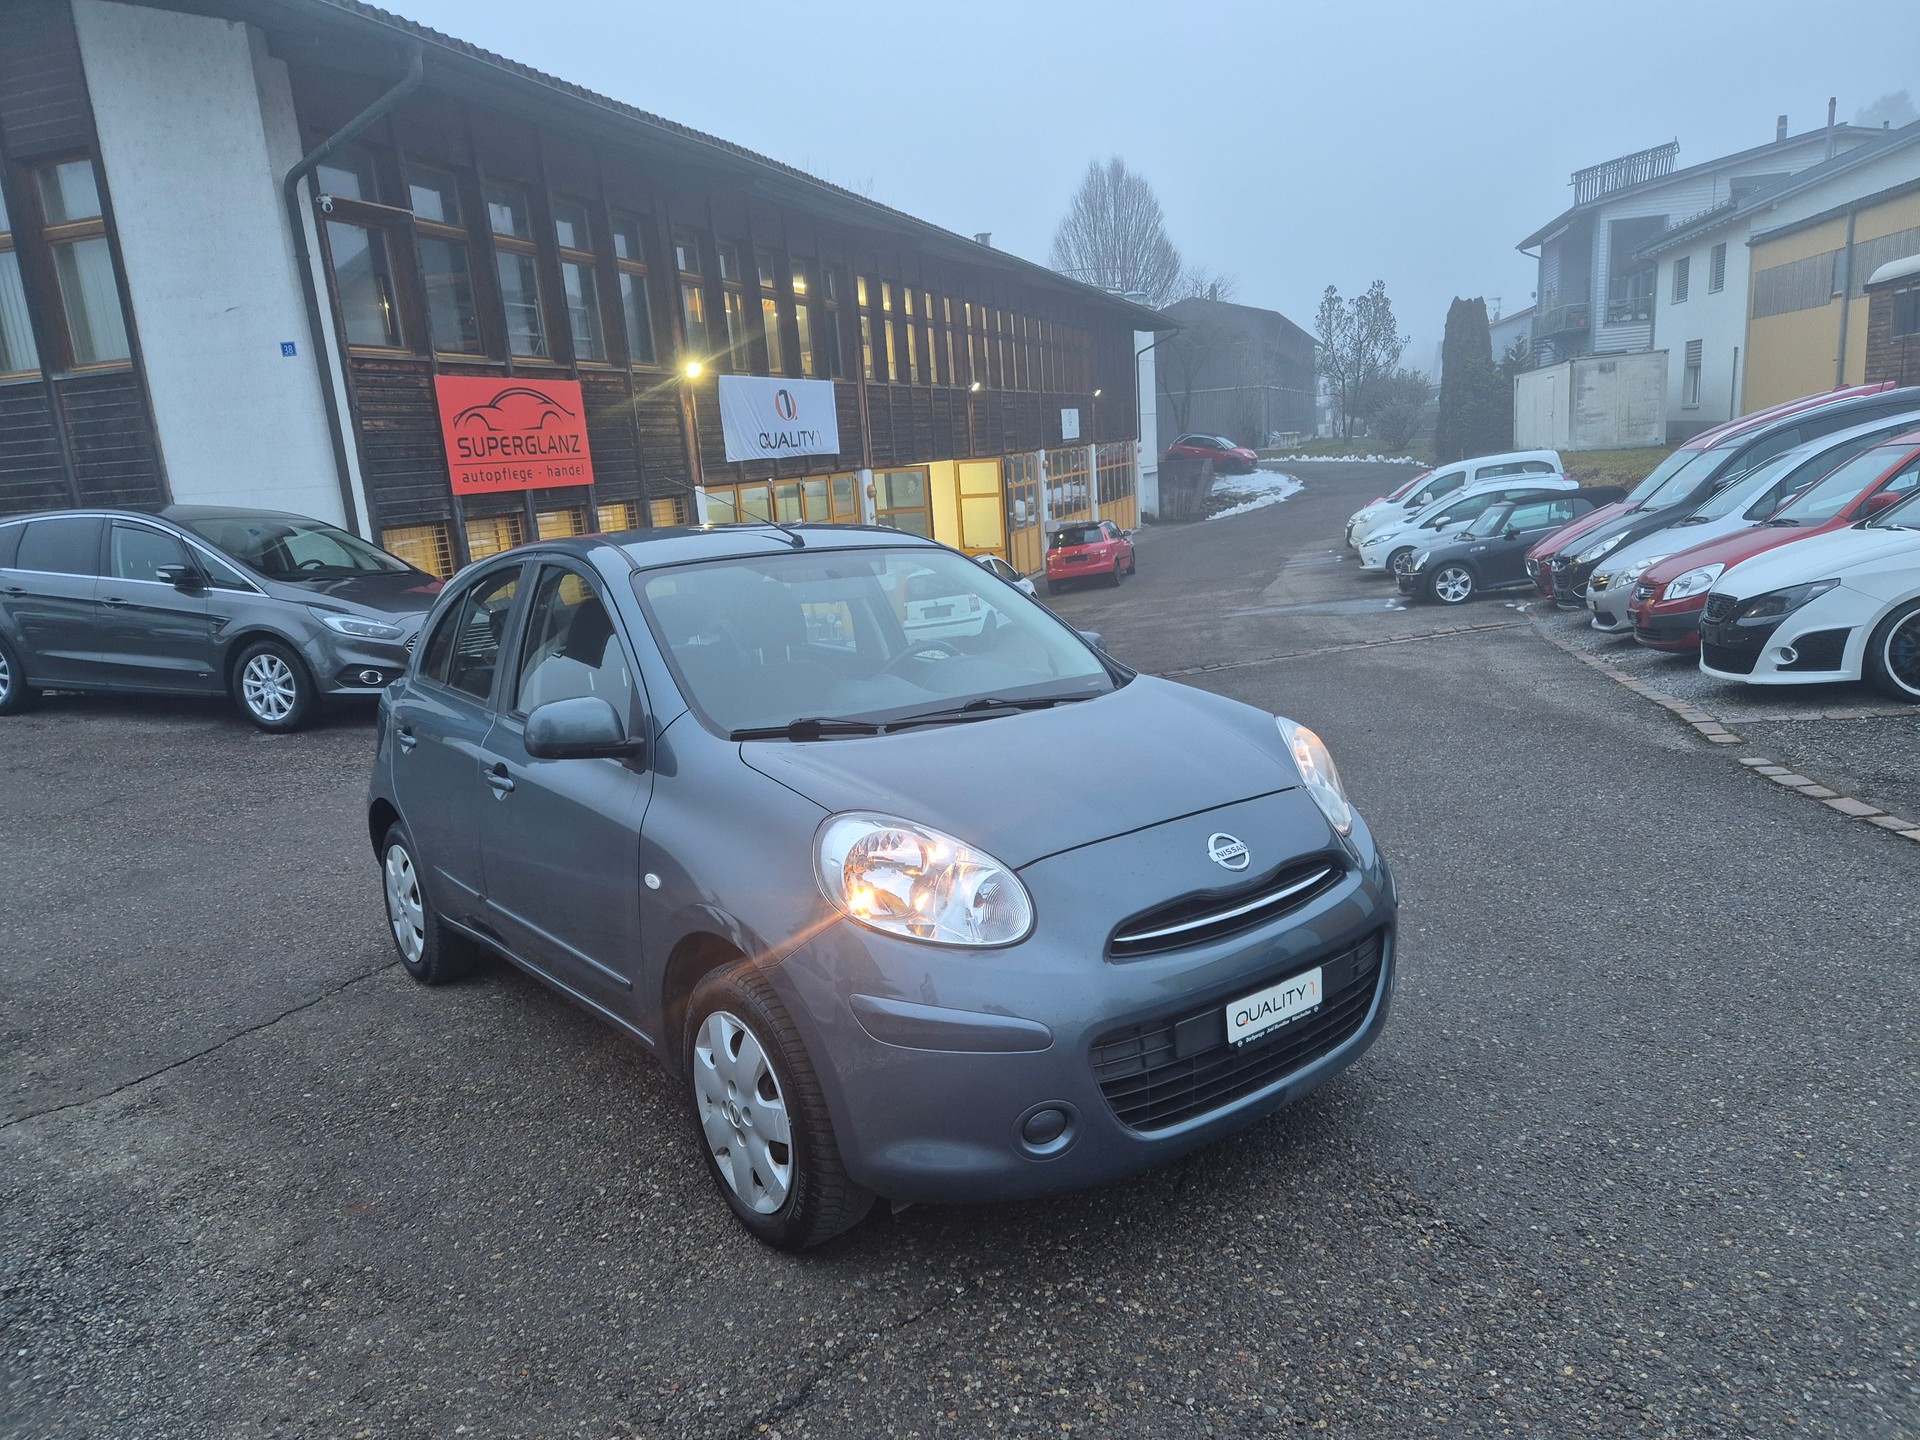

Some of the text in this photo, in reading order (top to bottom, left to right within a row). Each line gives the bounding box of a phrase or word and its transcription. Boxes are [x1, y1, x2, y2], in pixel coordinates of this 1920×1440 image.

[283, 344, 294, 355] 38
[457, 434, 581, 458] SUPERGLANZ
[462, 468, 533, 484] autopflege
[547, 464, 585, 477] handel
[1216, 843, 1247, 859] NISSAN
